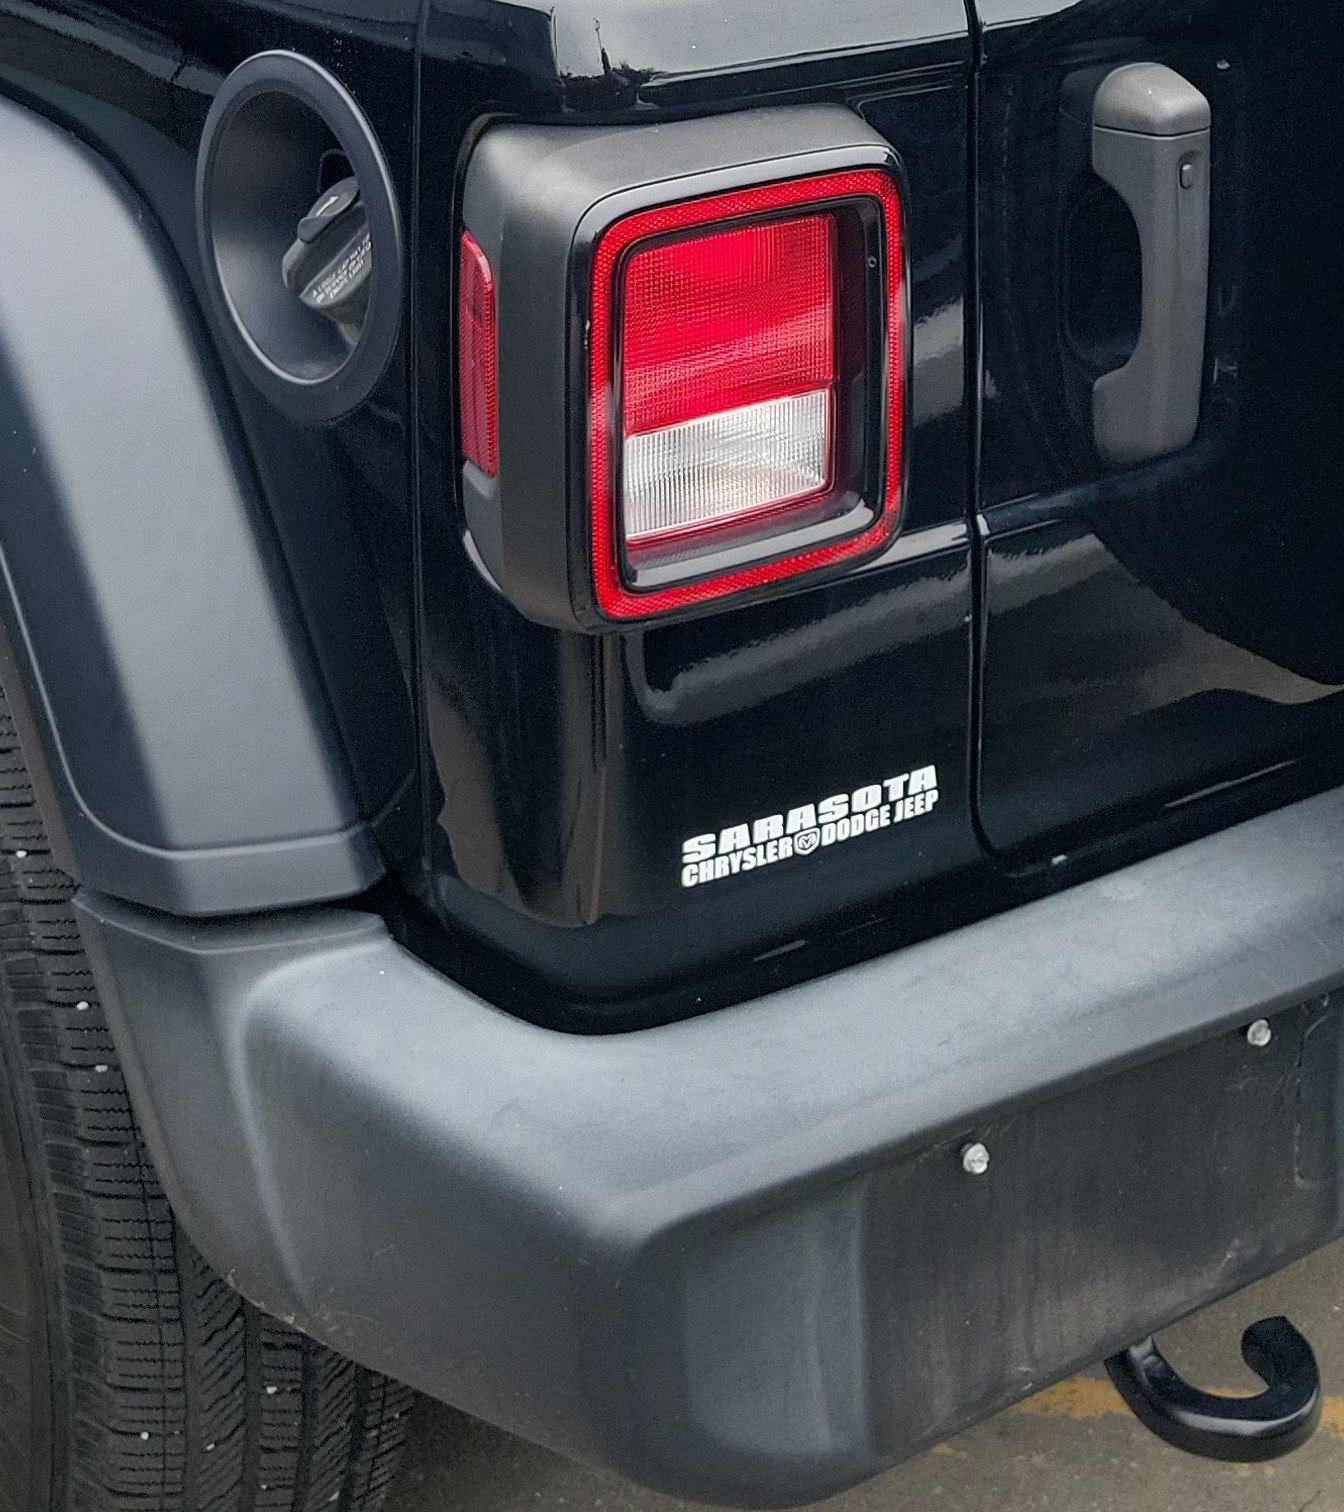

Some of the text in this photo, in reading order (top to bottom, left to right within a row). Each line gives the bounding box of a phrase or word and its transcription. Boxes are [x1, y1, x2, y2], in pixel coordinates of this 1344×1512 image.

[681, 789, 939, 888] CHRYSLER DODGE JEEP
[682, 764, 938, 864] SARASOTA
